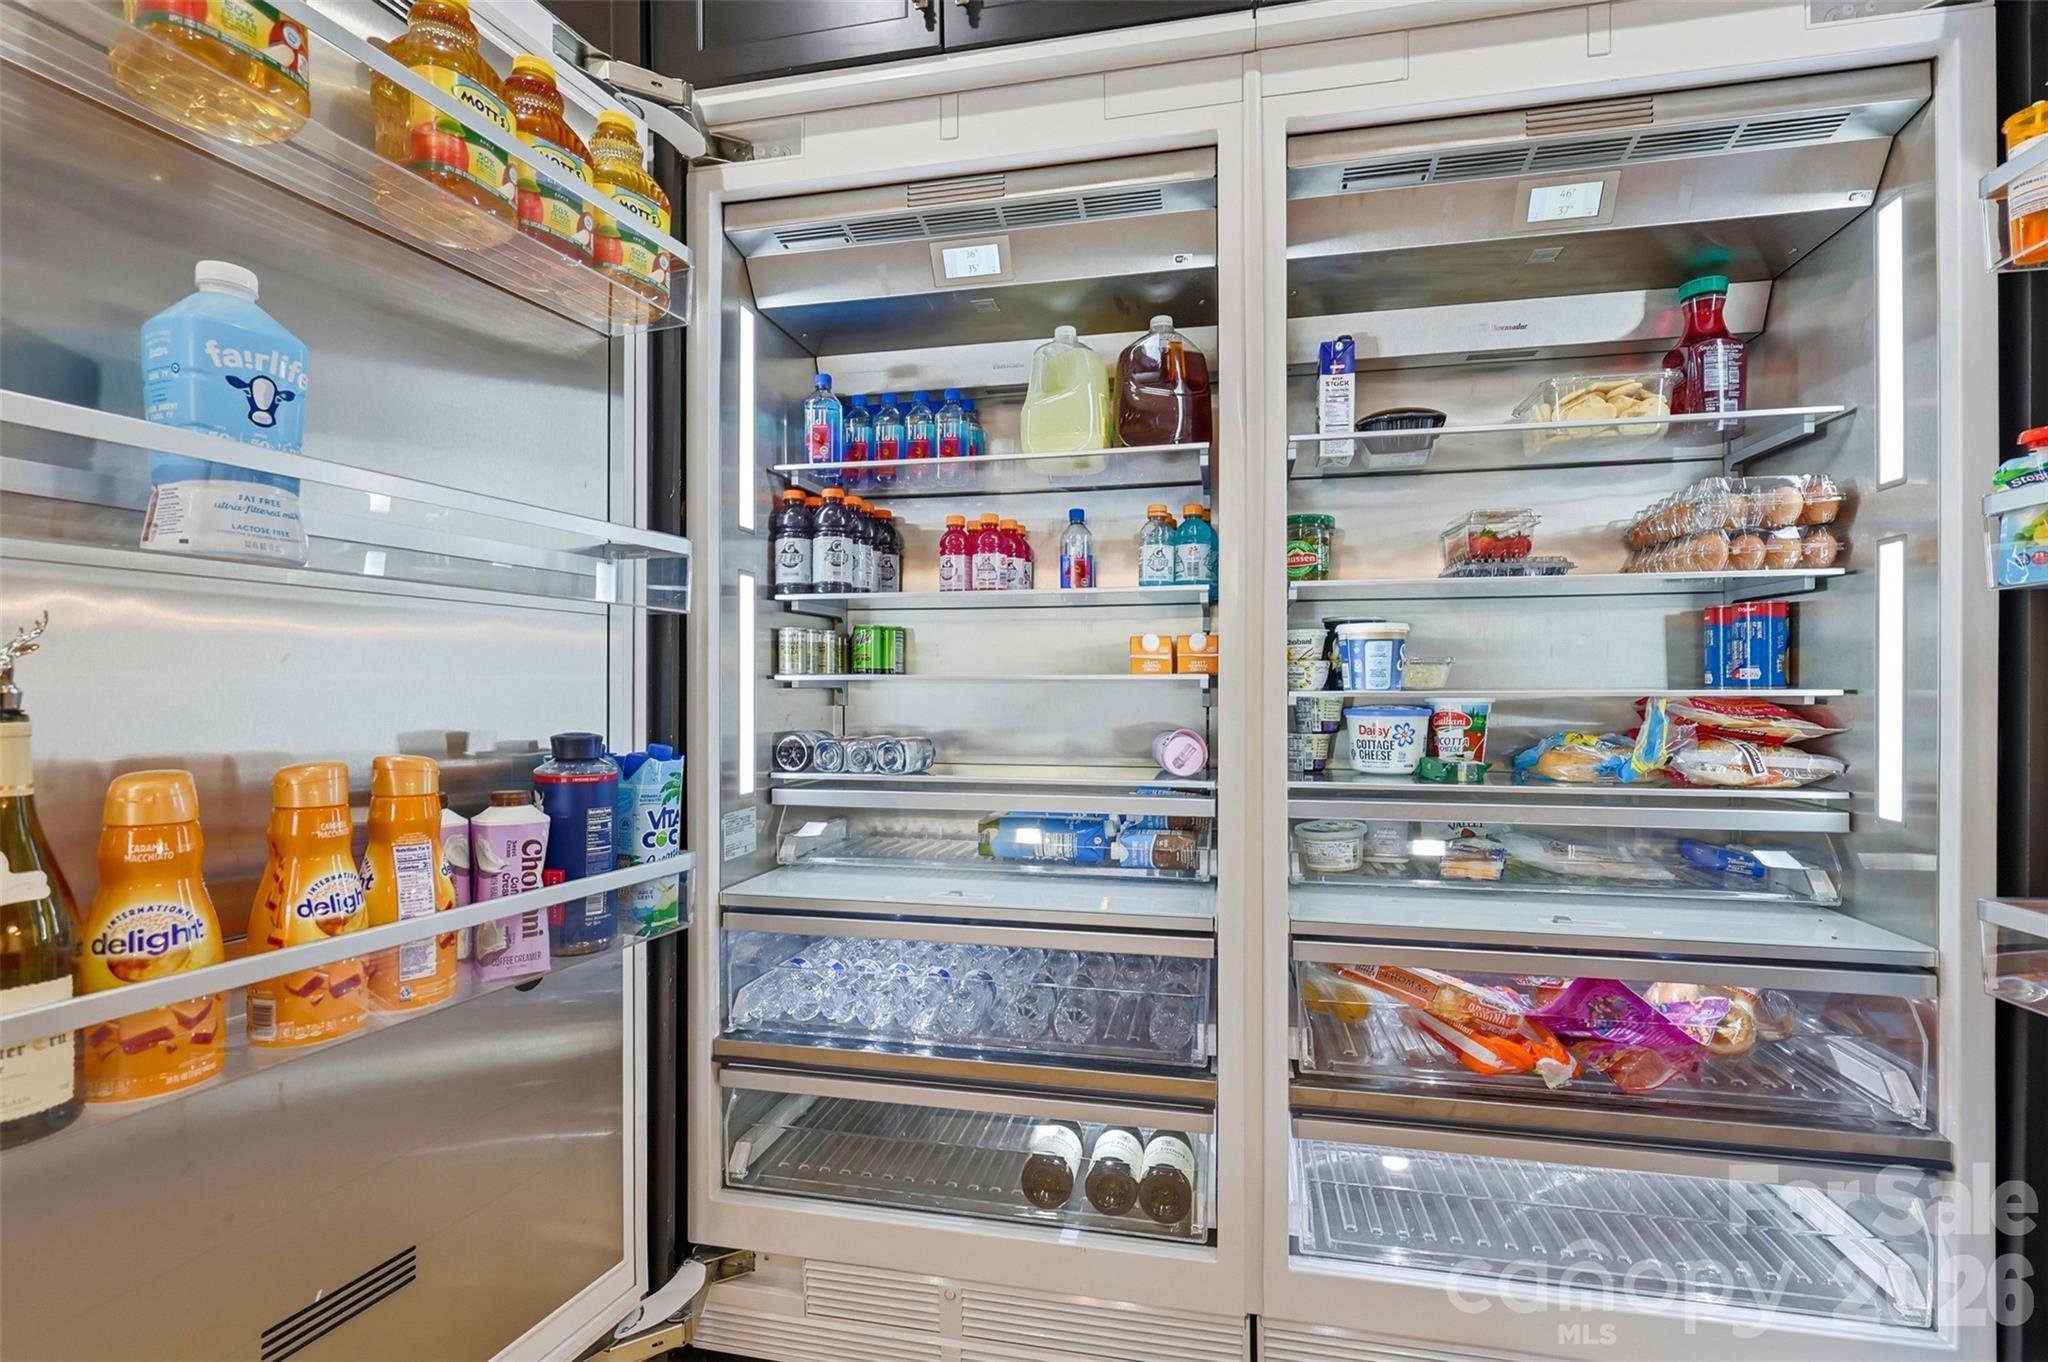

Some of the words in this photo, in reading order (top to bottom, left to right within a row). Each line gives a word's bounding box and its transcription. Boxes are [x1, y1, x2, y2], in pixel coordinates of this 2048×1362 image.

[238, 494, 256, 503] FAT
[231, 523, 270, 535] LACTOSE
[1287, 638, 1313, 646] hobani
[1358, 724, 1390, 739] Daisy
[1356, 739, 1396, 750] COTTAGE
[1359, 749, 1393, 761] CHEESE
[646, 806, 680, 830] VITA
[297, 887, 364, 919] deligh
[107, 904, 194, 930] INTERNATIONAL
[91, 918, 204, 956] delight
[514, 951, 543, 963] CREAMER
